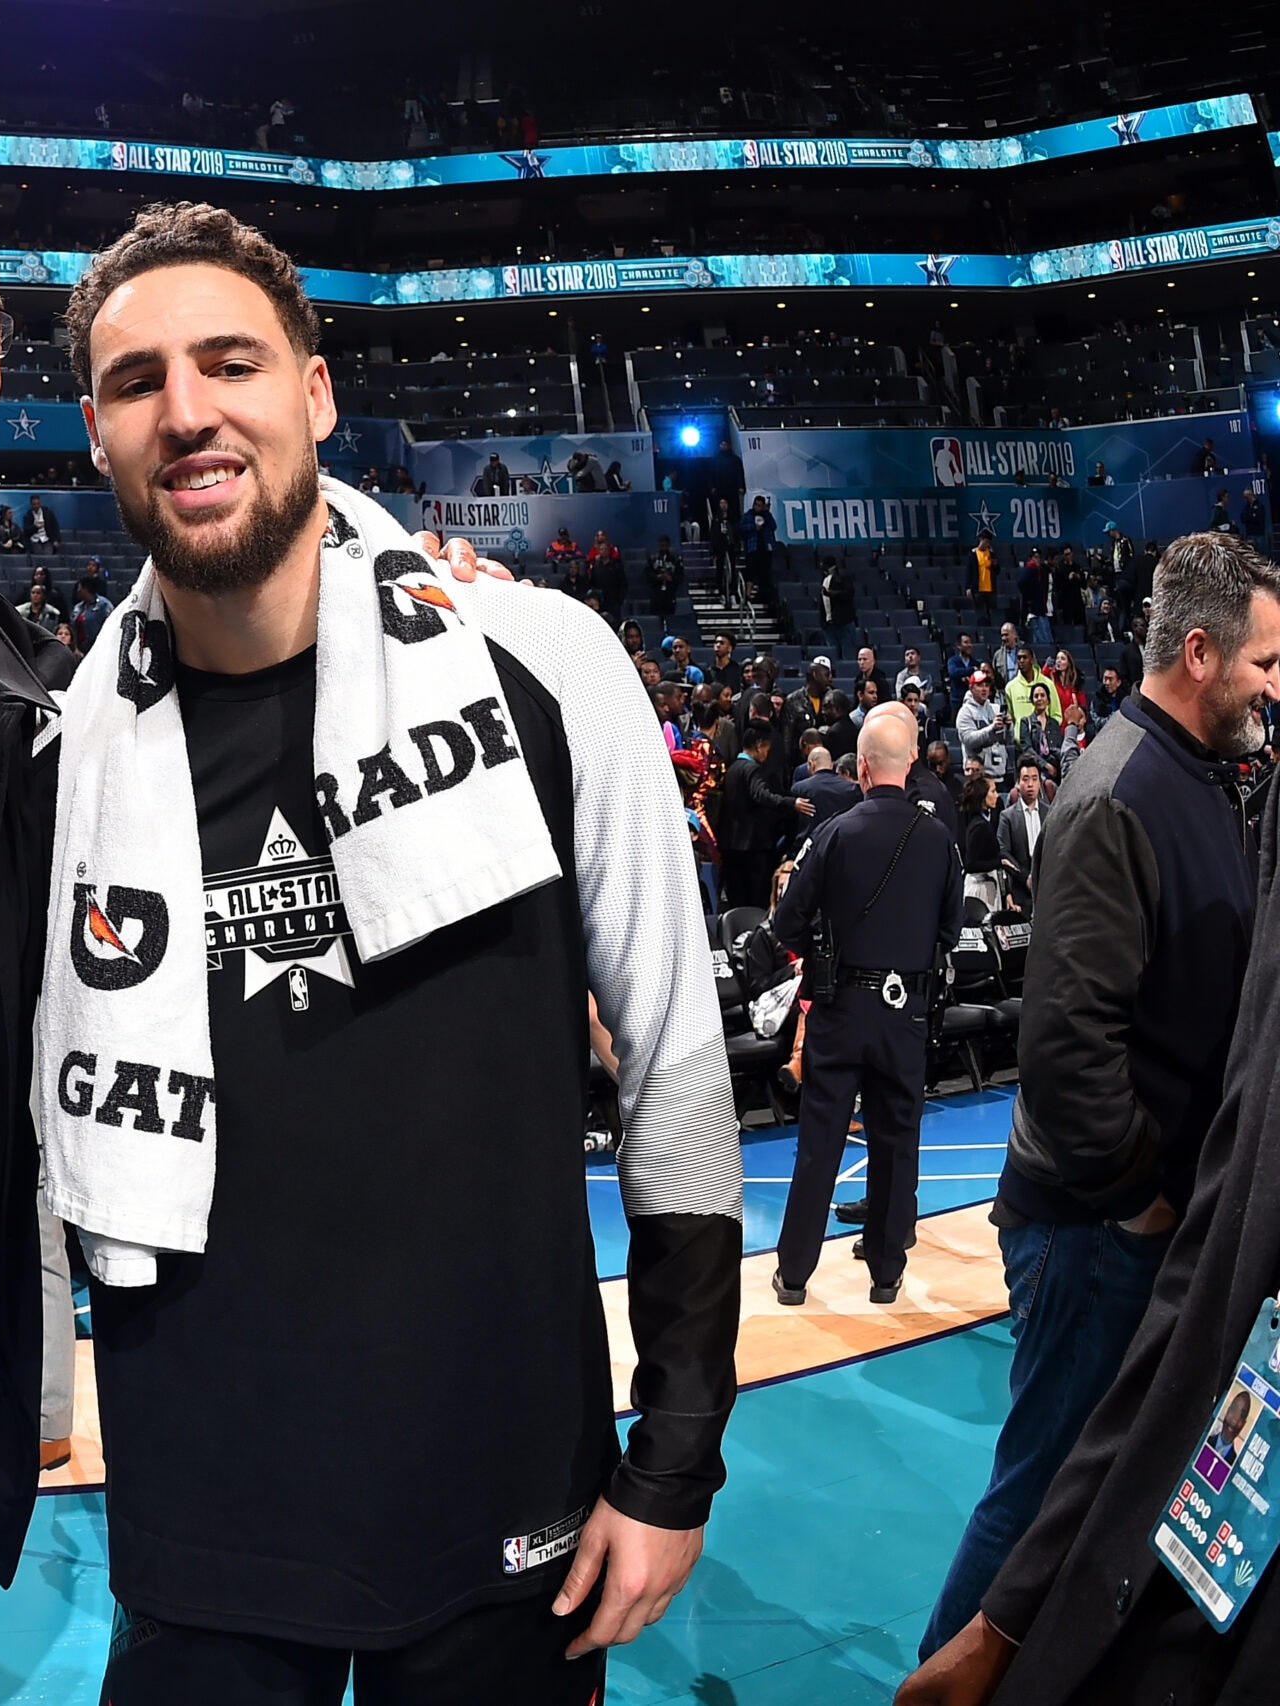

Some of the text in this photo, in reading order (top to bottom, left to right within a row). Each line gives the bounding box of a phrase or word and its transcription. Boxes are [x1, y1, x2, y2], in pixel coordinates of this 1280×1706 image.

[193, 149, 224, 175] 2019
[229, 160, 285, 173] CHARLOTTE
[820, 141, 849, 166] 2019
[852, 148, 903, 158] CHARLOTTE
[1180, 230, 1209, 260] 2019
[1211, 231, 1262, 247] CHARLOTTE
[585, 262, 617, 290] 2019
[622, 268, 680, 280] CHARLOTTE
[1230, 420, 1242, 433] 107
[748, 437, 761, 450] 107
[1038, 442, 1075, 476] 2019
[1252, 479, 1265, 495] 107
[502, 502, 529, 525] 2019
[654, 499, 668, 513] 107
[783, 498, 1060, 540] CHARLOTTE 2019
[58, 1050, 216, 1143] GAT
[532, 1536, 544, 1546] XL
